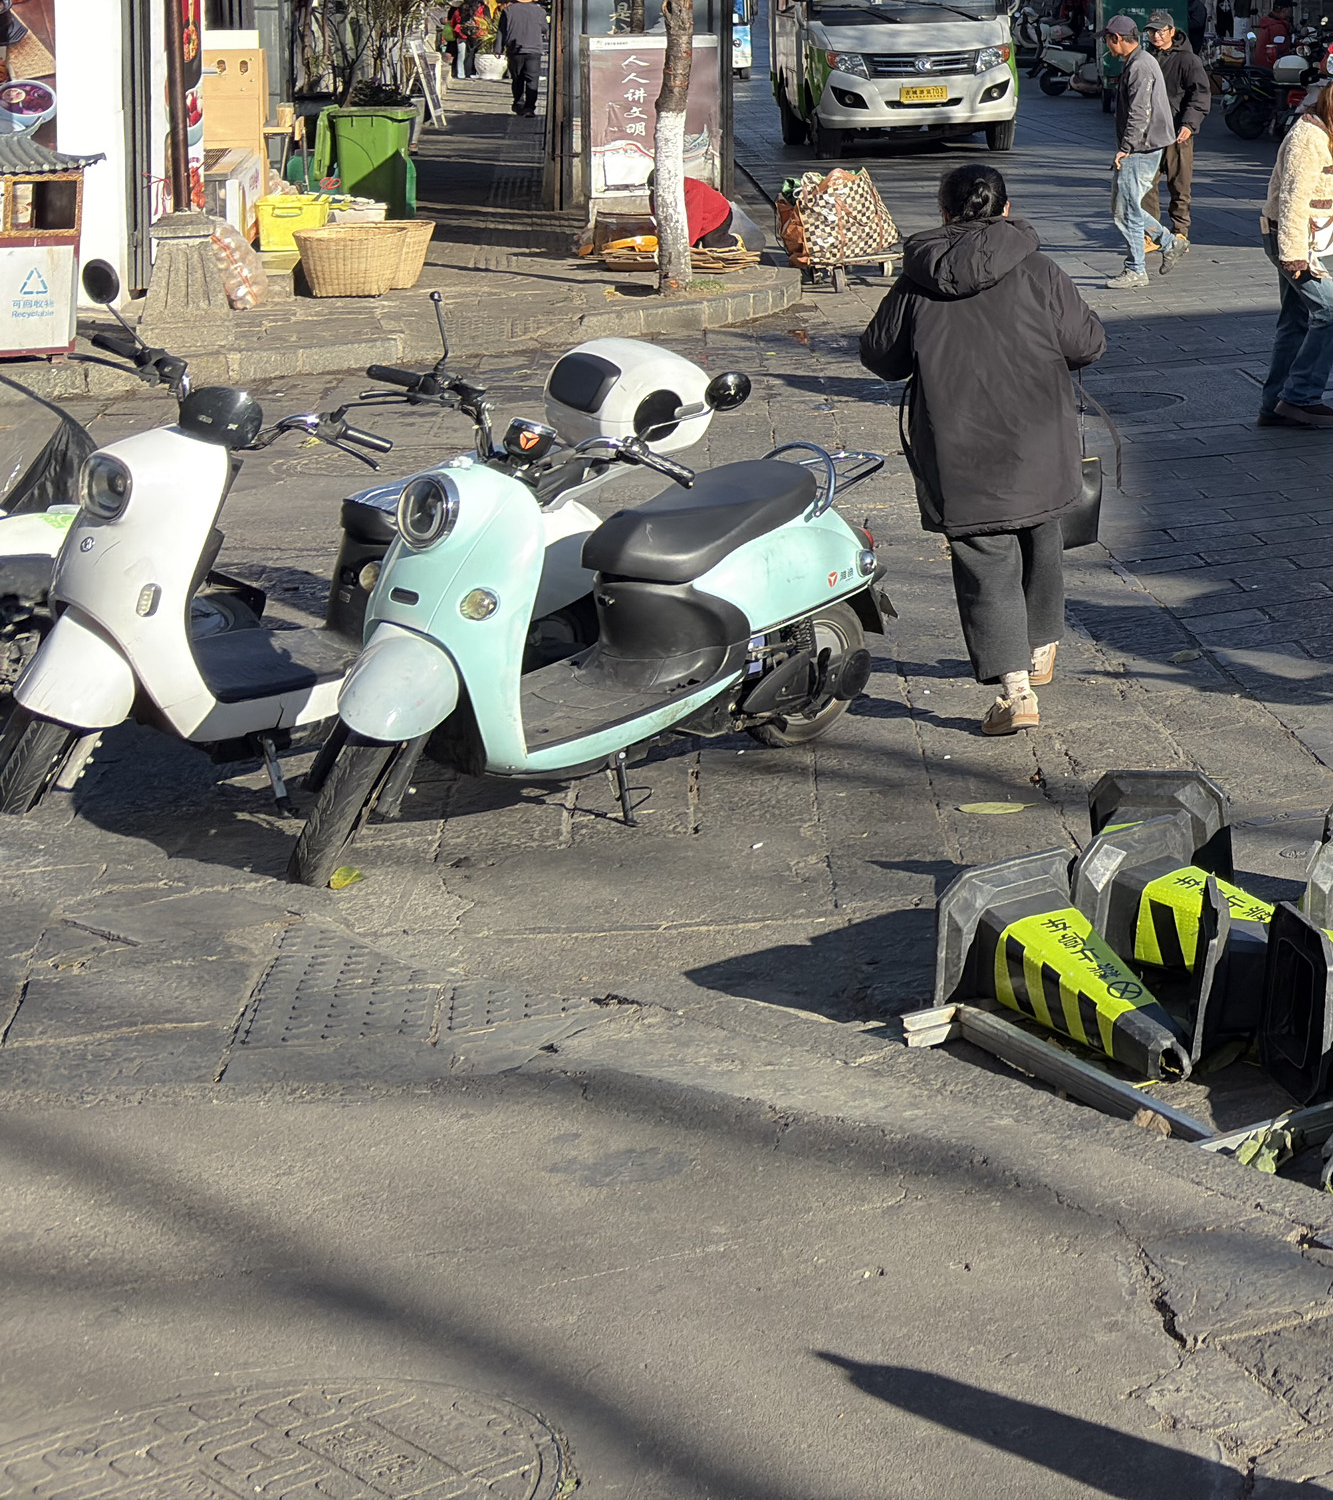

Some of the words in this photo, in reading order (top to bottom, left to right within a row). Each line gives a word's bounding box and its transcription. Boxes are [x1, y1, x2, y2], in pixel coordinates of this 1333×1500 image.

[621, 54, 650, 137] 人人讲文明
[11, 310, 55, 318] Recyclable
[1173, 874, 1273, 922] 禁止车
[1040, 917, 1121, 980] 禁止停车
